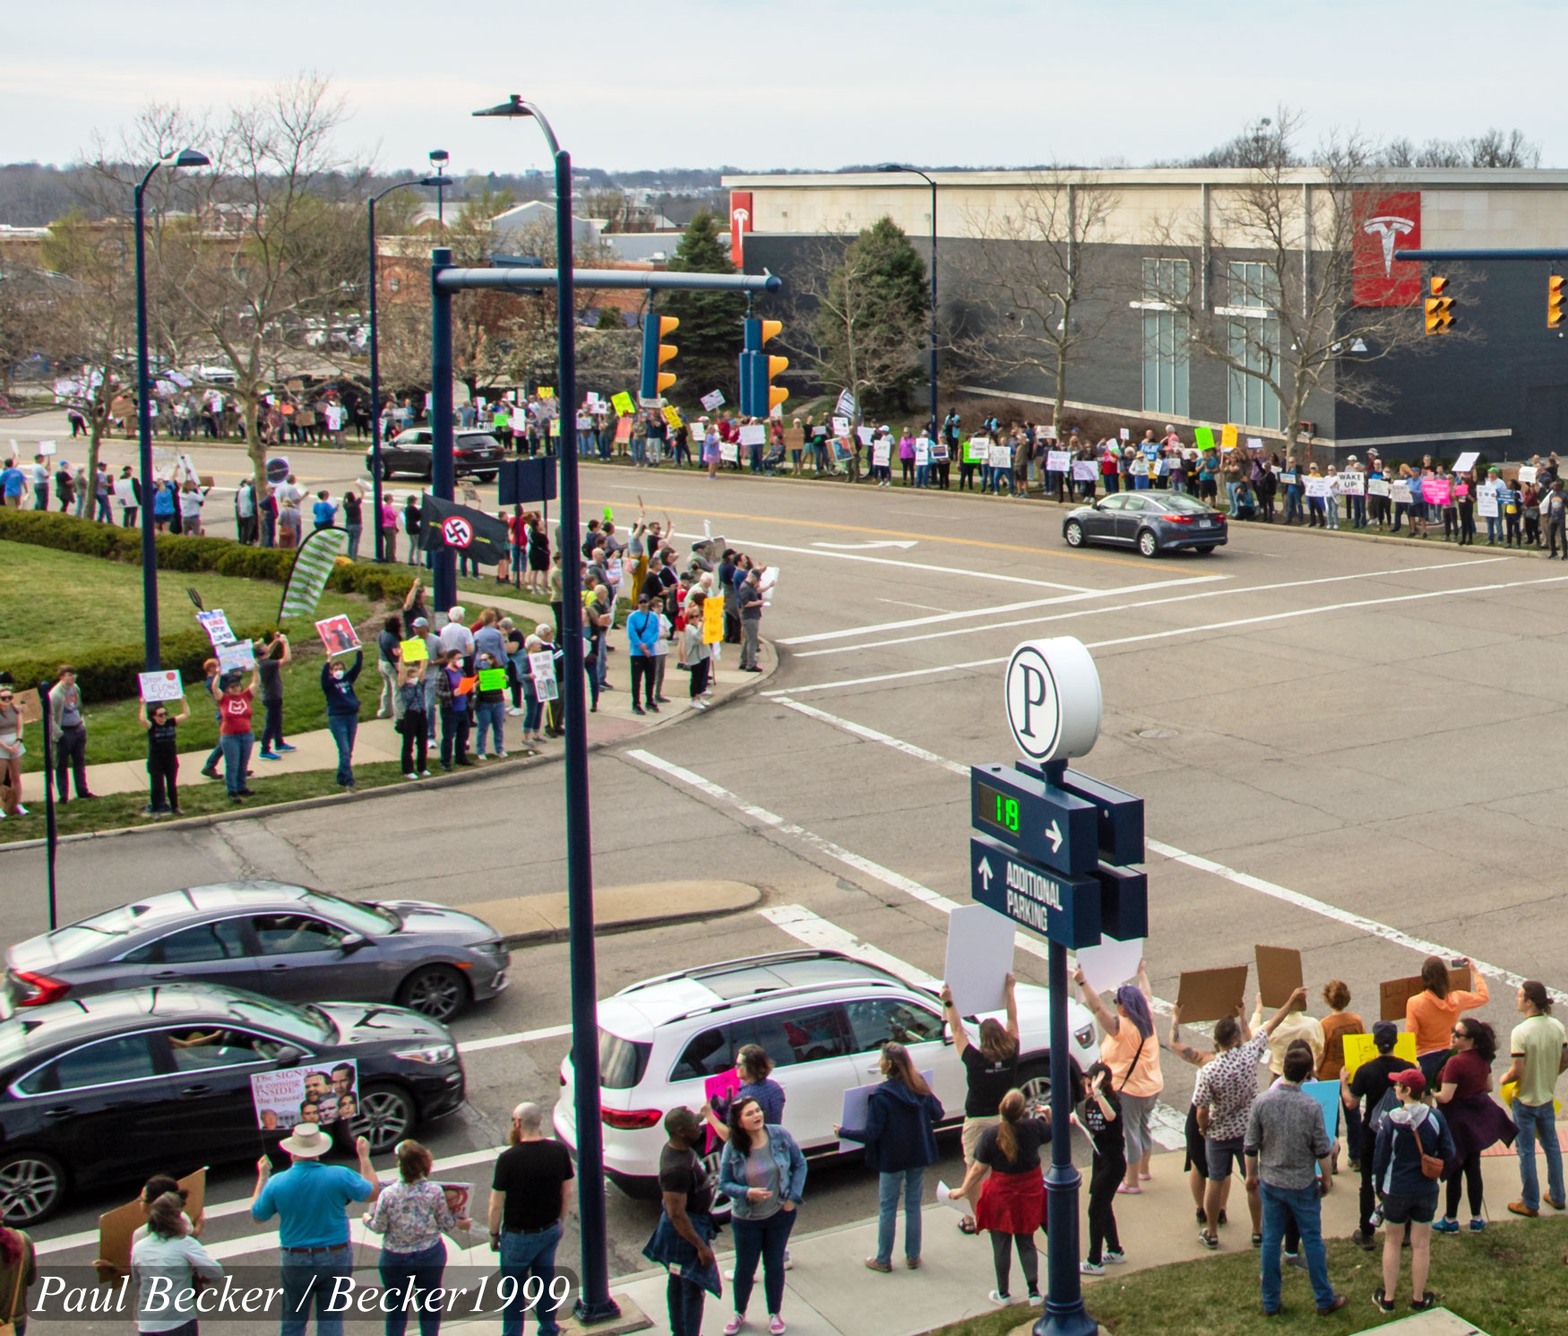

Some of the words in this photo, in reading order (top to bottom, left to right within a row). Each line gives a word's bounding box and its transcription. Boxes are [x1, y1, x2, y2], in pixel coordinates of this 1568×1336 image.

[1019, 663, 1046, 738] P
[996, 795, 1019, 832] 119
[1006, 861, 1063, 911] ADDITIONAL
[1006, 888, 1048, 931] PARKING
[256, 1087, 296, 1097] INSIDE
[266, 1080, 300, 1089] coming
[275, 1068, 314, 1079] SIGNAL
